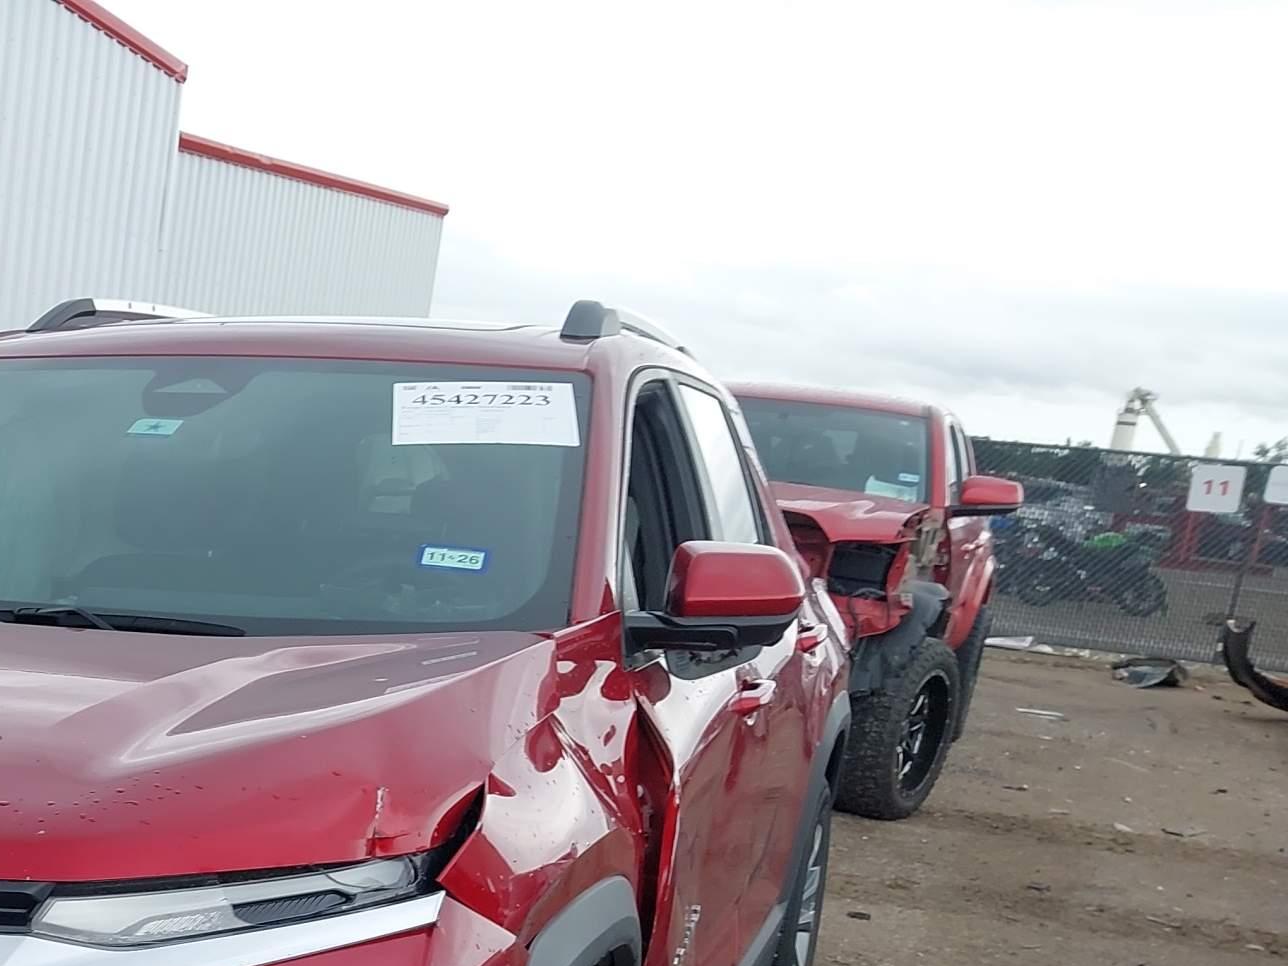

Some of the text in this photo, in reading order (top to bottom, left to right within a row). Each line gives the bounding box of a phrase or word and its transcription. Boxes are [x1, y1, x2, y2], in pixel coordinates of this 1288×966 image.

[412, 393, 551, 406] 45427223
[1203, 479, 1230, 496] 11
[427, 551, 480, 565] 11-26
